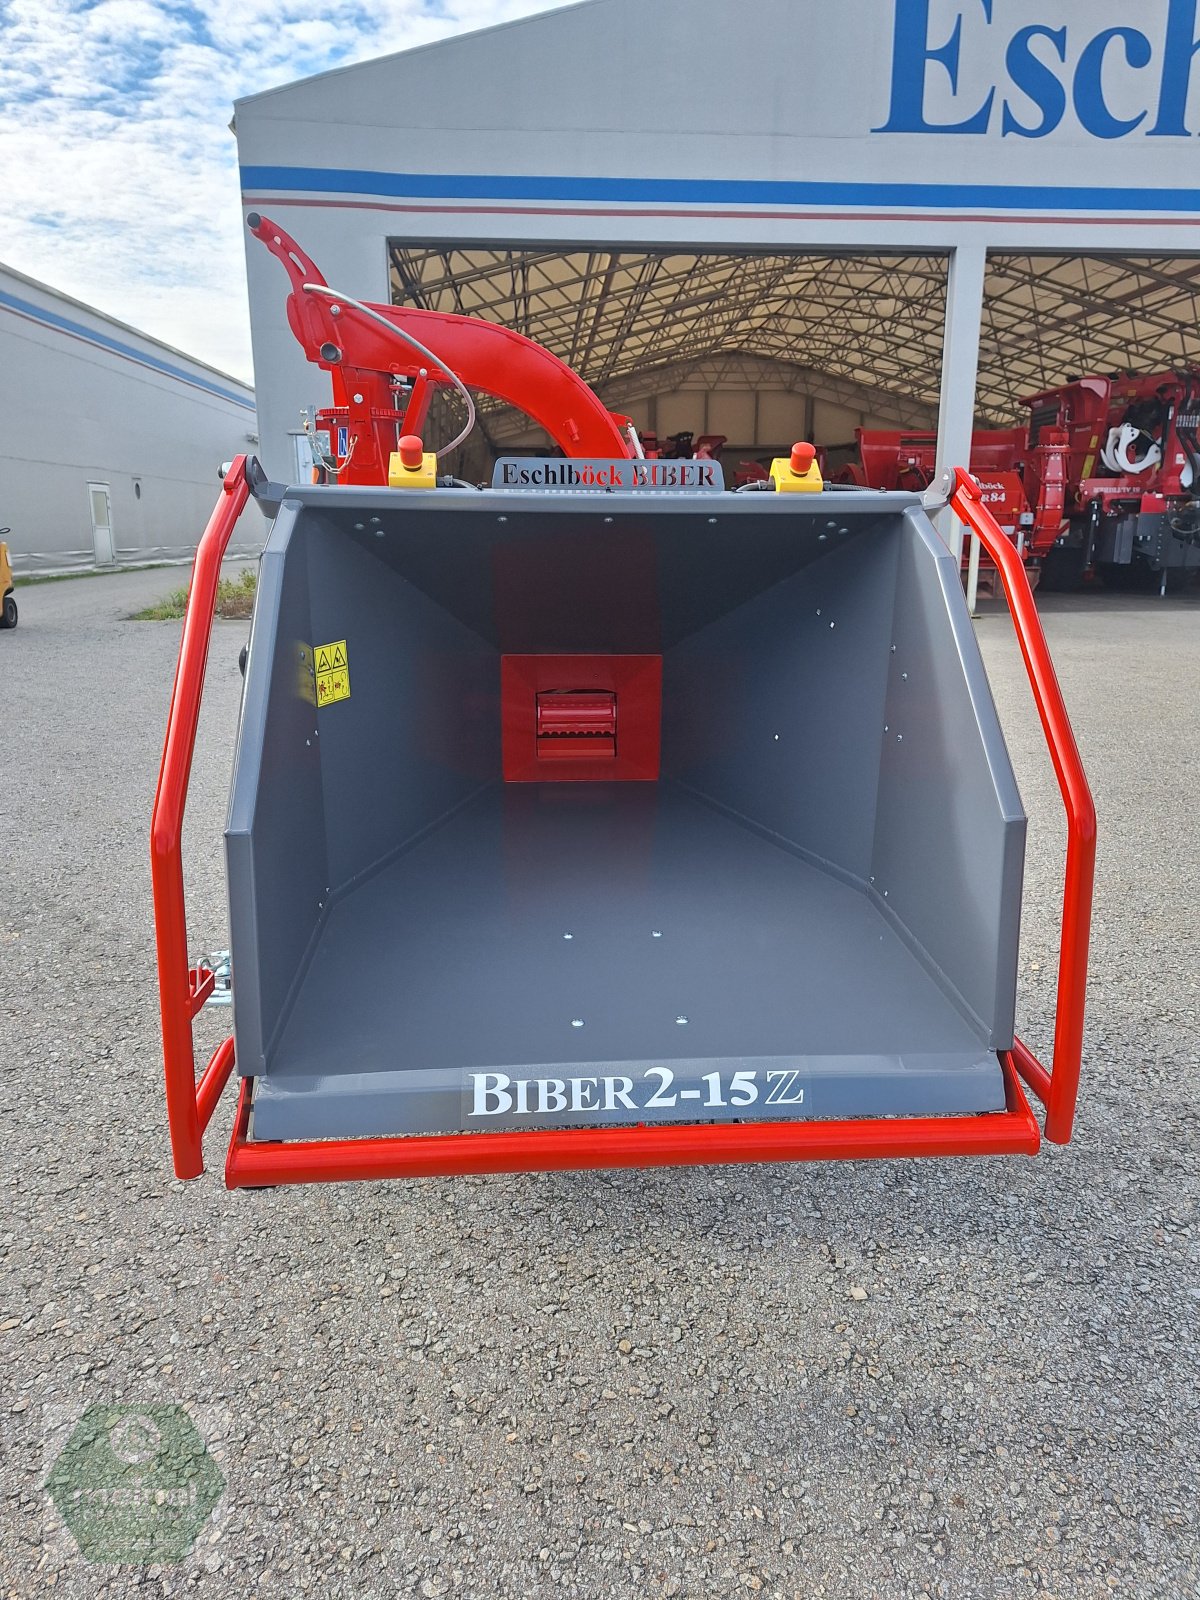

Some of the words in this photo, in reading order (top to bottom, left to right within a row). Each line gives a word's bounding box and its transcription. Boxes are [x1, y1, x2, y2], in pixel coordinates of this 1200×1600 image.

[502, 463, 622, 486] Eschlböck
[632, 464, 716, 486] BIBER
[468, 1072, 639, 1116] BIBER
[643, 1066, 759, 1108] 2-15
